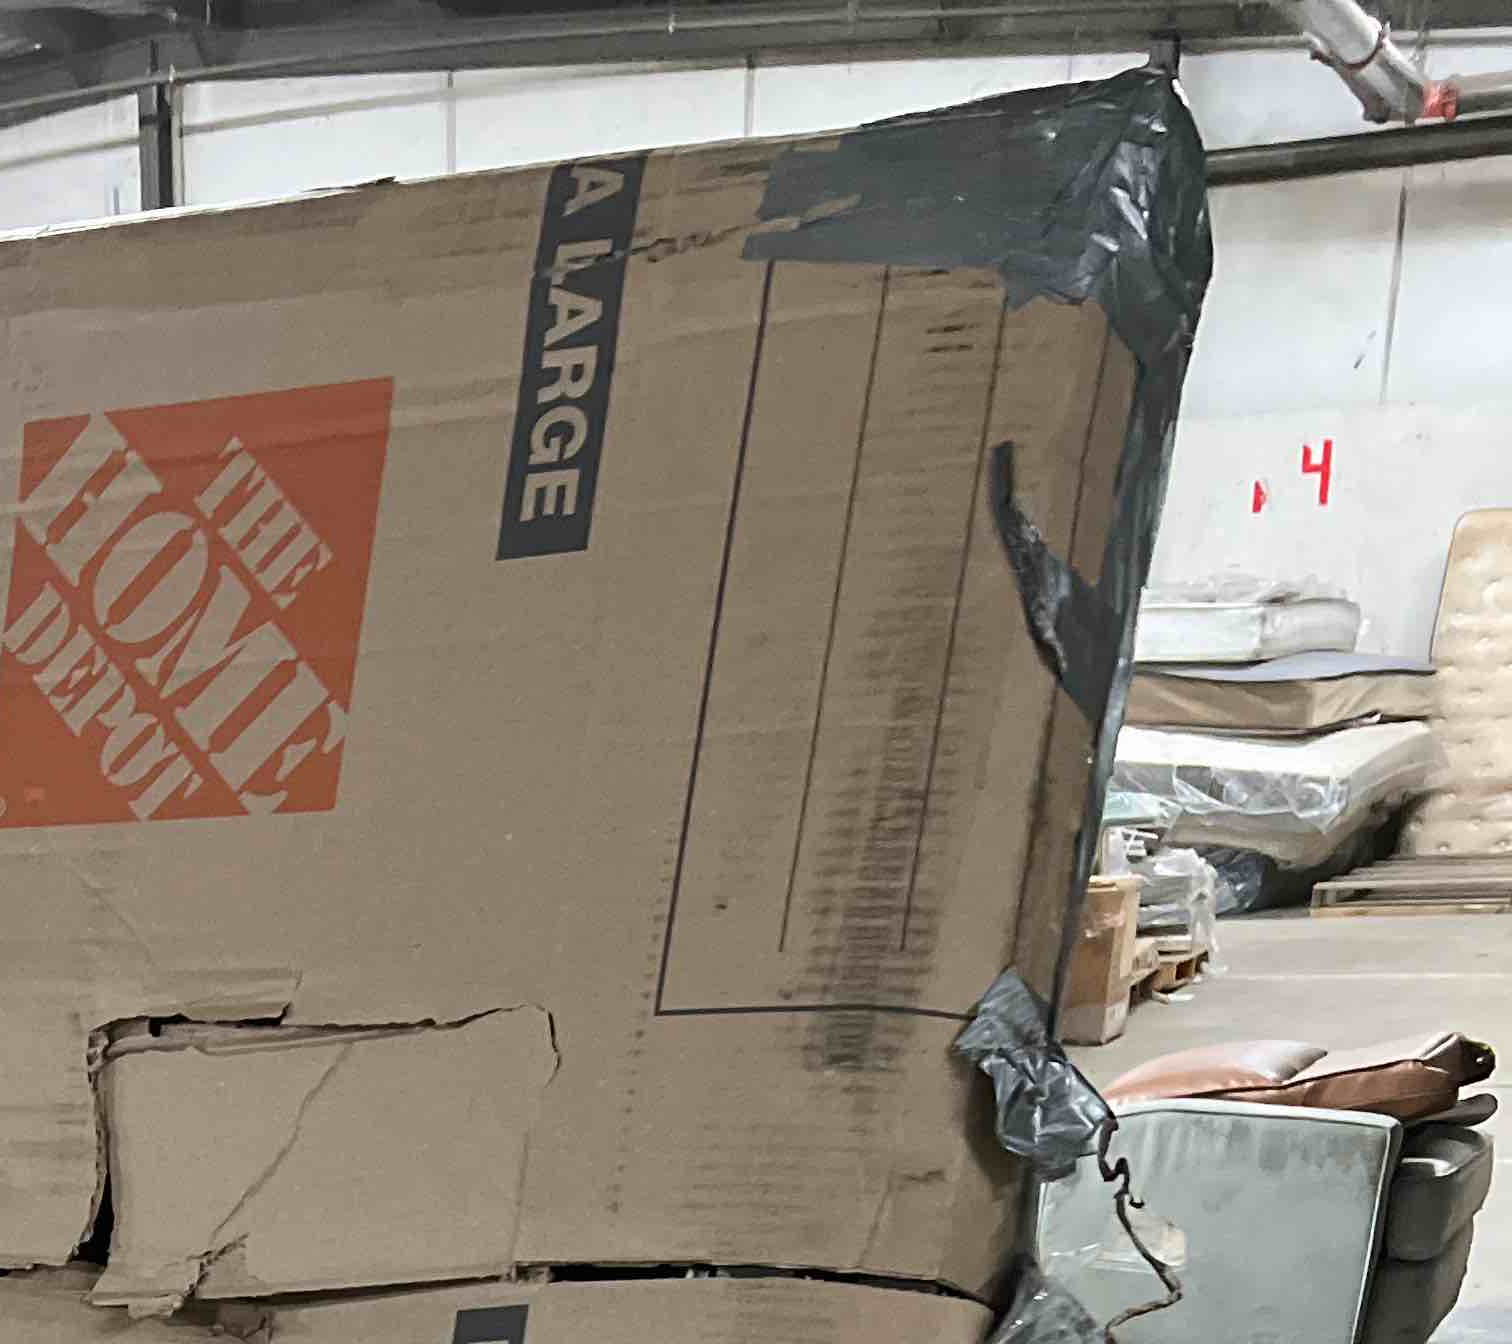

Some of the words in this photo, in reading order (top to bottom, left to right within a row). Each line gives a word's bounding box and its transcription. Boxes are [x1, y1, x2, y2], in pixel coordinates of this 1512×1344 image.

[518, 238, 615, 524] LARGE
[1302, 438, 1333, 505] 4
[18, 412, 351, 815] HOME
[194, 435, 334, 609] THE
[0, 581, 204, 822] DEPOT
